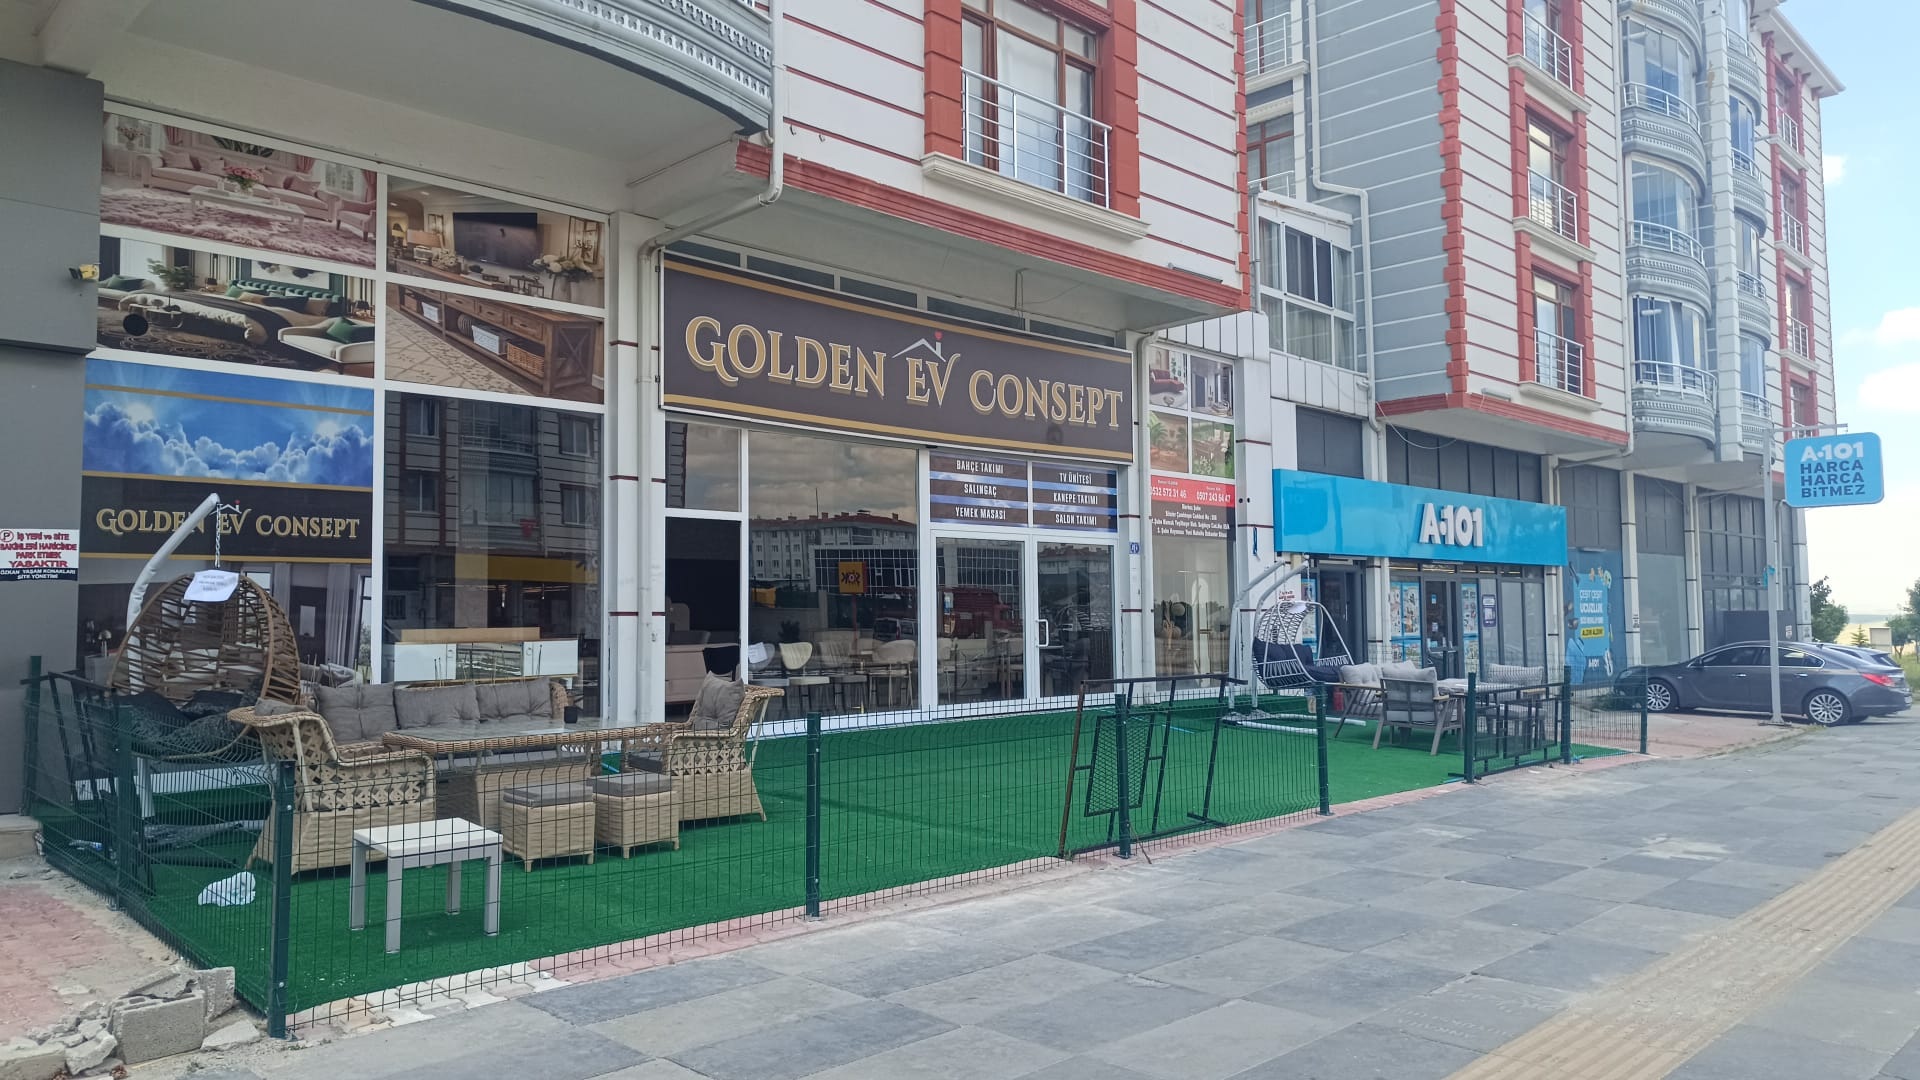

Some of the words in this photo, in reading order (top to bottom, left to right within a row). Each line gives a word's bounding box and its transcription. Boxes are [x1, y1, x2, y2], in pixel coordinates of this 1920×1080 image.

[684, 316, 887, 397] GOLDEN
[905, 353, 960, 408] EV
[969, 369, 1123, 428] CONSEPT
[956, 460, 979, 472] BAHÇE
[981, 462, 1004, 475] TAKIMI
[1800, 460, 1864, 474] HARCA
[1059, 472, 1067, 482] TV
[1068, 472, 1092, 485] ÜNİTESİ
[1801, 472, 1865, 486] HARCA
[1053, 492, 1076, 503] KANEPE
[1077, 494, 1098, 505] TAKIMI
[955, 507, 979, 518] YEMEK
[980, 508, 1006, 520] MASASI
[1055, 513, 1075, 524] SALON
[1076, 515, 1097, 525] TAKIMI
[255, 515, 360, 538] CONSEPT
[16, 551, 35, 559] PARK
[9, 560, 68, 568] YASAKTIR
